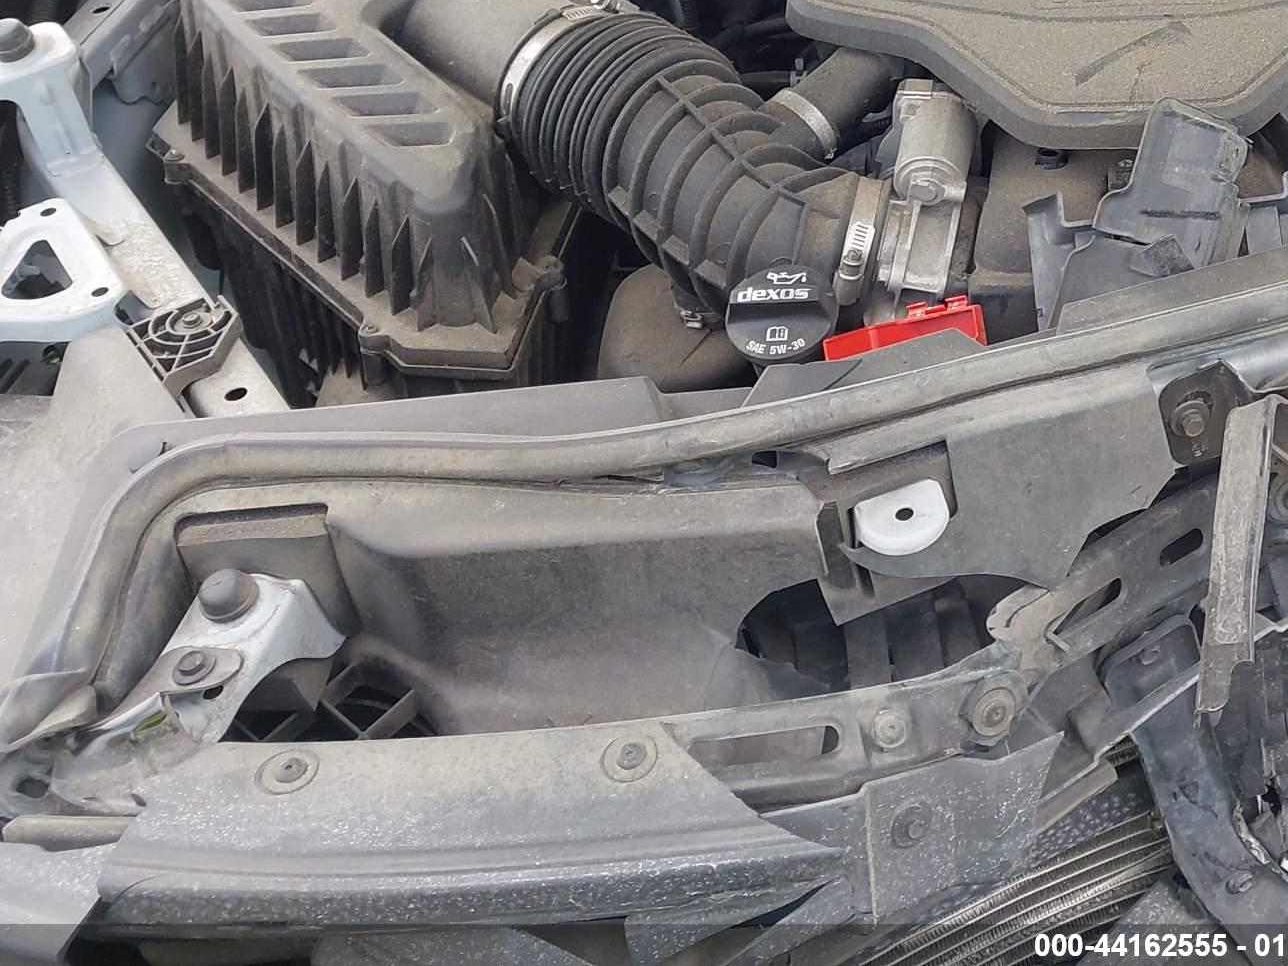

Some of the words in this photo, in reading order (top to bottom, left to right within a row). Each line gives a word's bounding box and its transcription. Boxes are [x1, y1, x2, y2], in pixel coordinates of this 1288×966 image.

[737, 287, 812, 302] dexos
[746, 341, 766, 354] SAE
[769, 338, 805, 355] 5W-30
